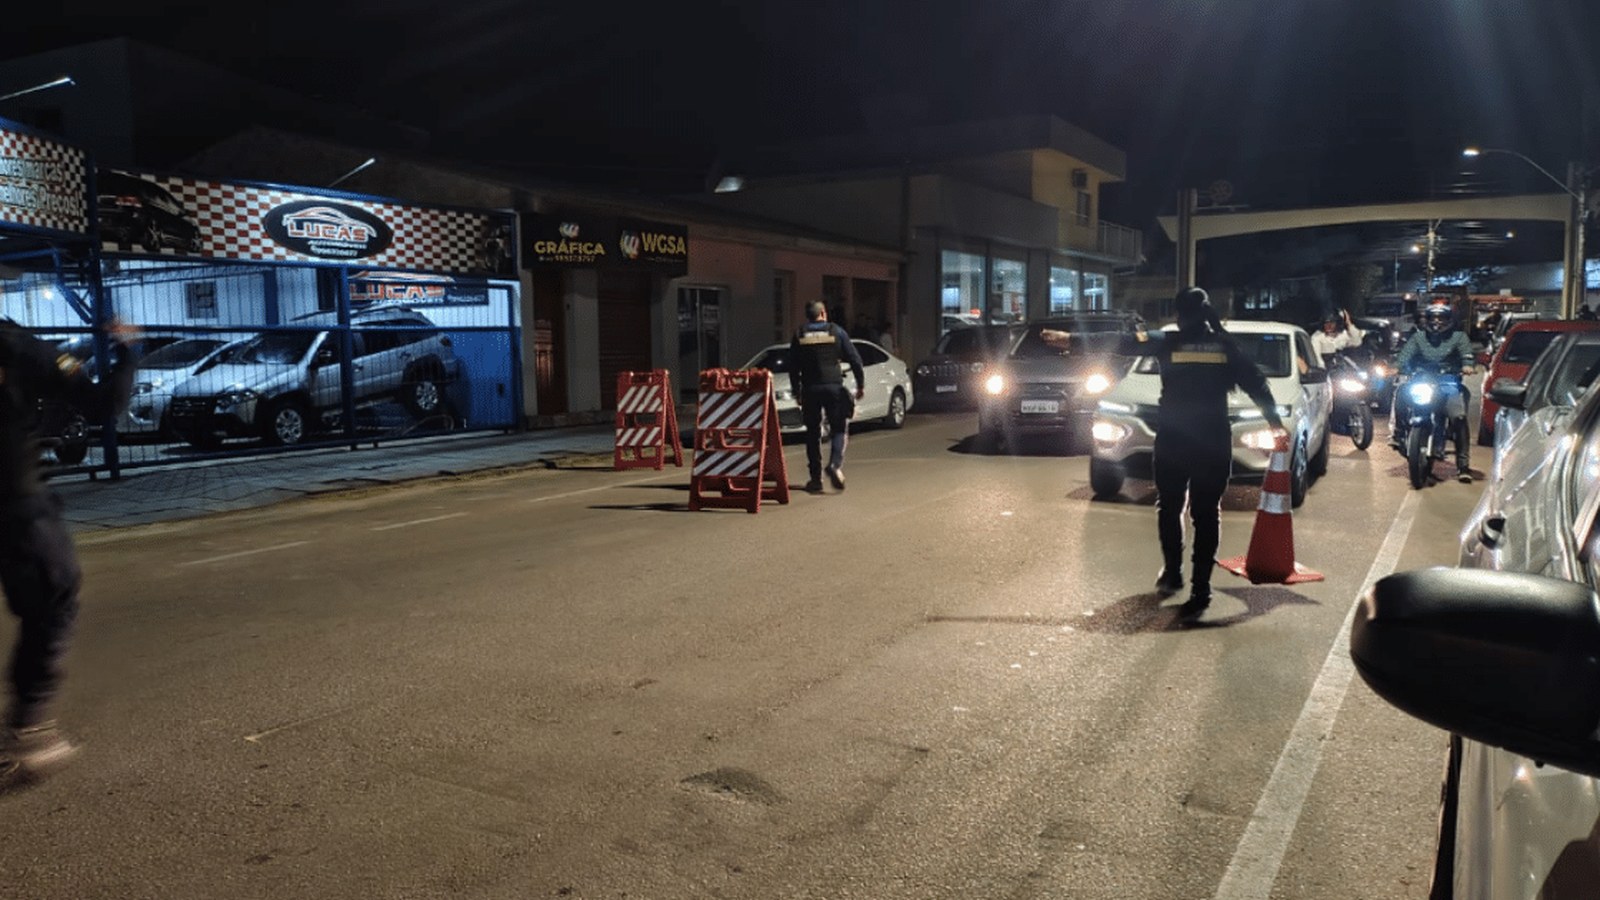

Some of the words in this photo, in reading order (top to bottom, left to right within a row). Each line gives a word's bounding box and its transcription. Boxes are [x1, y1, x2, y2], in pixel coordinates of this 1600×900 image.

[286, 219, 368, 242] LUCAS
[534, 239, 605, 255] GRÁFICA
[641, 232, 686, 255] WGSA
[349, 283, 445, 300] LUCAS
